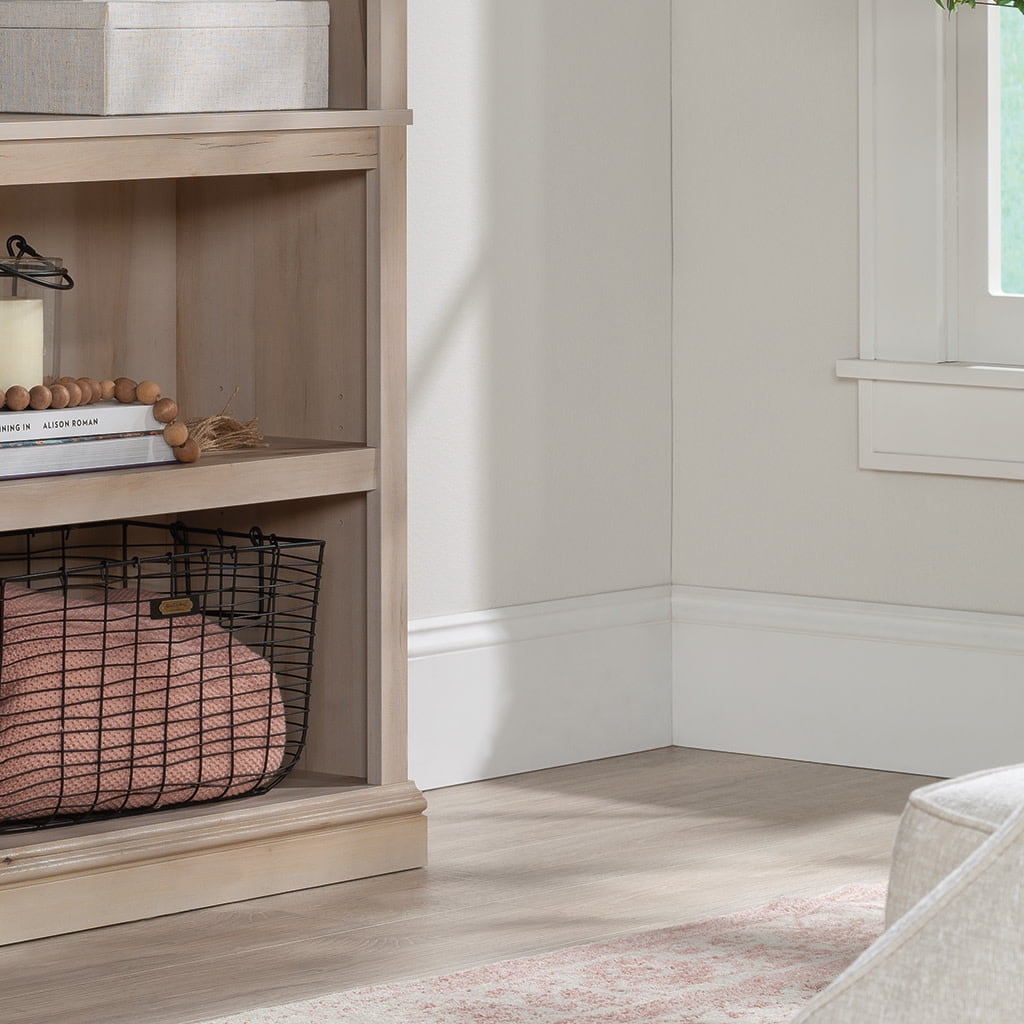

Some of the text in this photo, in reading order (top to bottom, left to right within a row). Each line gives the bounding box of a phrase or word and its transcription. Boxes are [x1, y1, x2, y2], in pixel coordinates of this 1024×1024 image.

[22, 423, 31, 432] IN
[42, 420, 70, 430] ALISON
[71, 417, 99, 428] ROMAN
